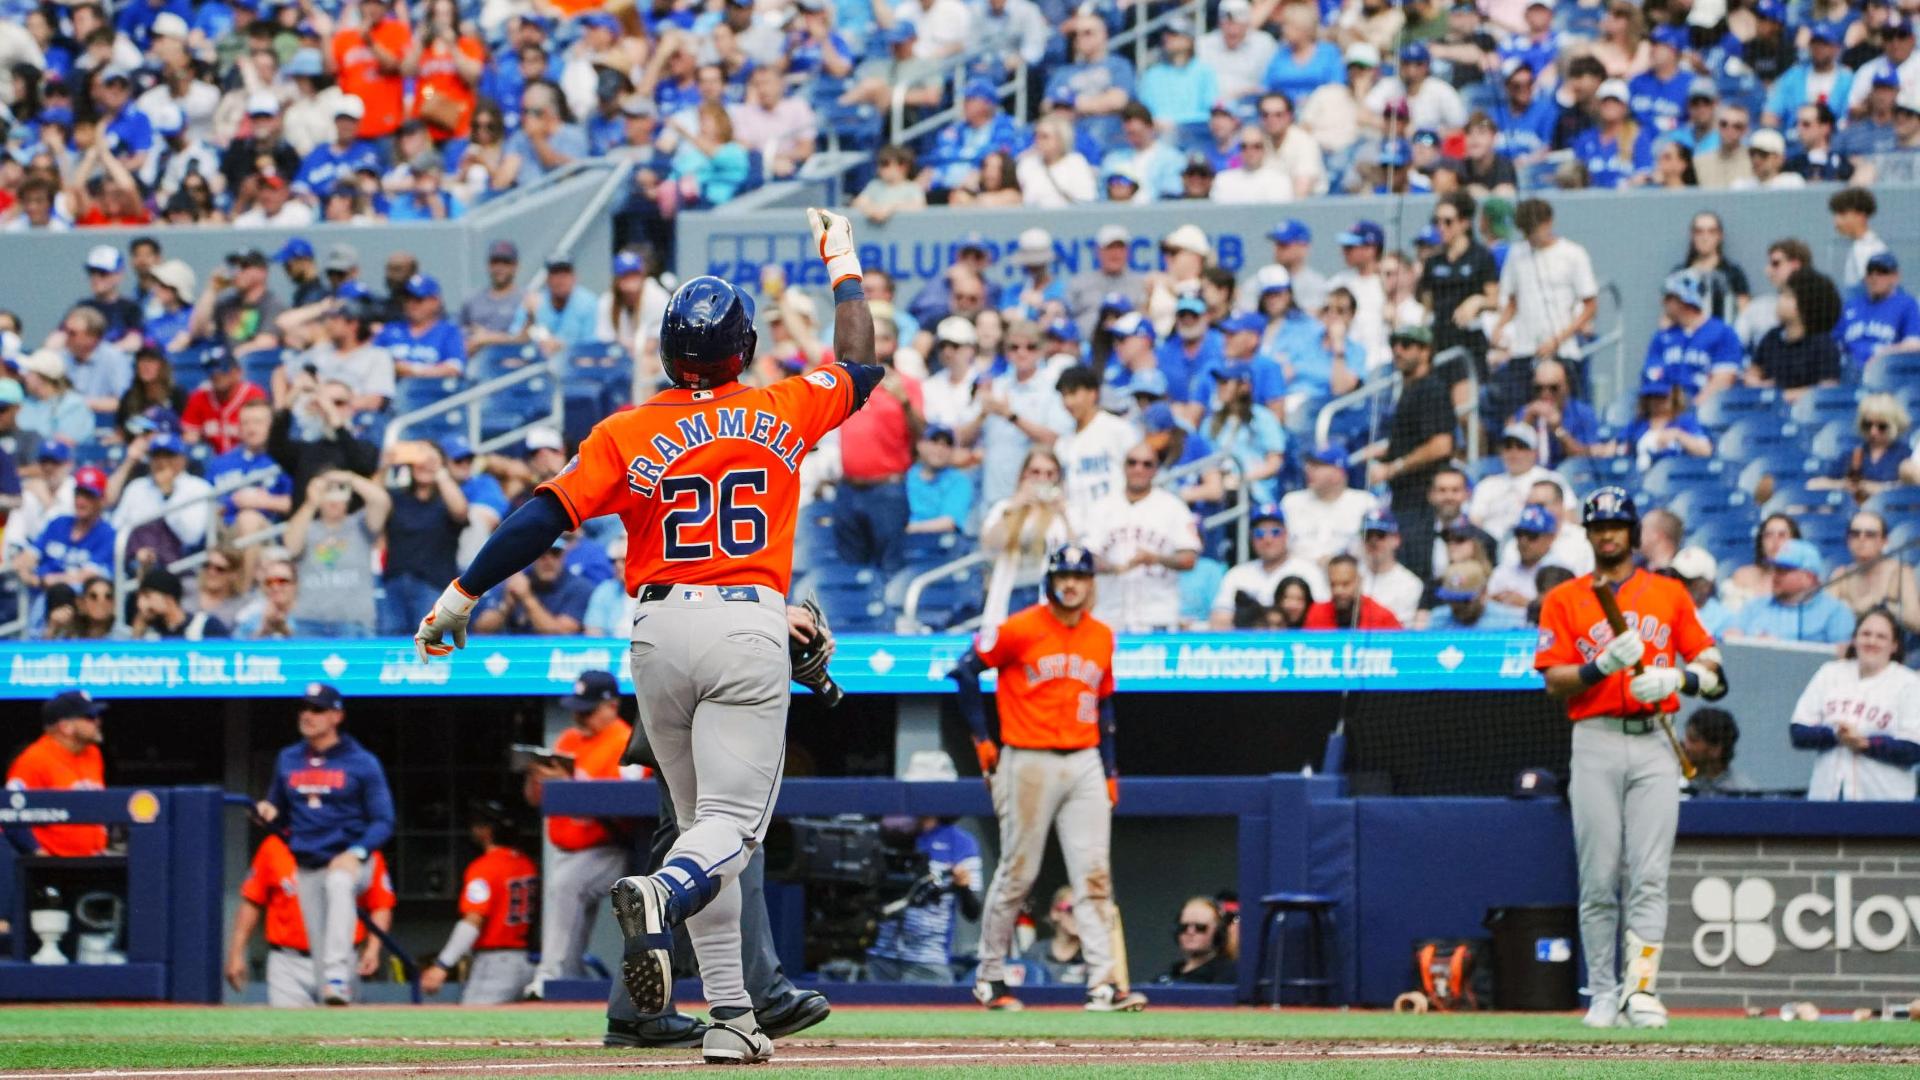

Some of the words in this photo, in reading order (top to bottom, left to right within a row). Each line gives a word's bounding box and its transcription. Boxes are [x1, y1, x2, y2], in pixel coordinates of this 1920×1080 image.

[627, 407, 804, 498] TRAMMELL
[660, 467, 768, 562] 26
[8, 653, 77, 686] Audit.
[79, 652, 184, 688] Advisory.
[186, 651, 233, 685] Tax.
[1175, 642, 1290, 682] Advisory.
[1291, 641, 1342, 678] Tax.
